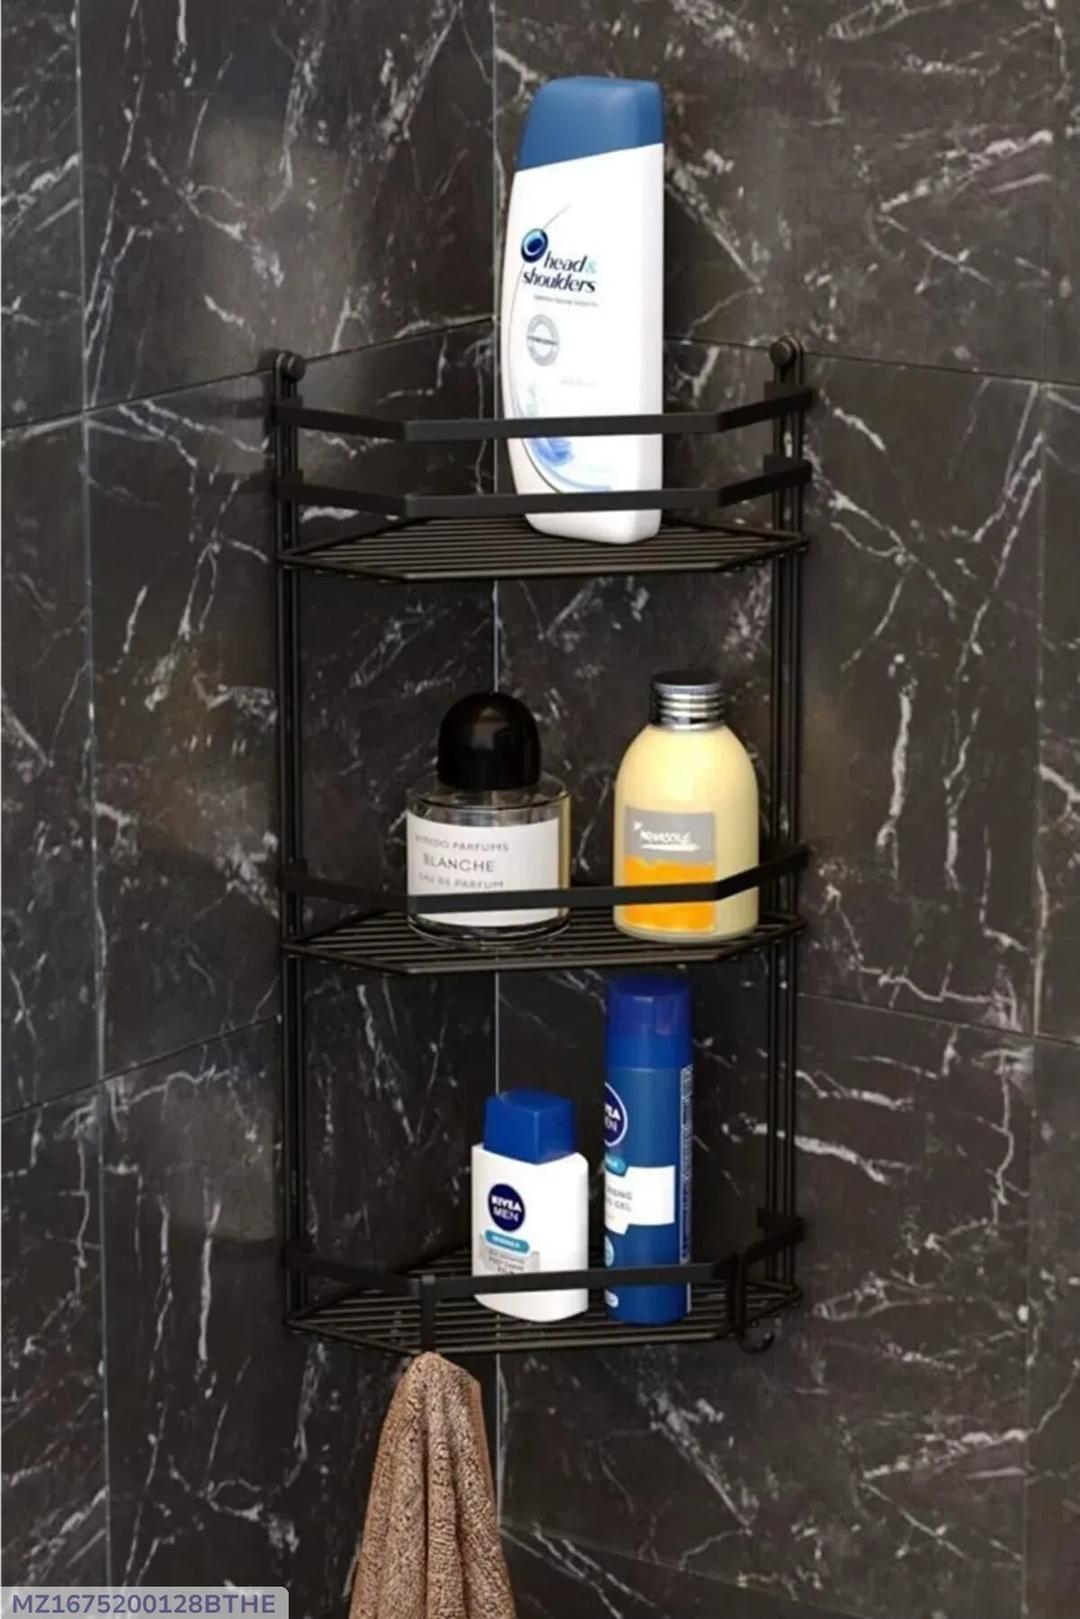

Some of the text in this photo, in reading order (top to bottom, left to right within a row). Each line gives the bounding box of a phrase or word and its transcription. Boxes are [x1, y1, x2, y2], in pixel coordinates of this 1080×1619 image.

[523, 267, 597, 293] shoulders
[453, 841, 510, 852] PARFUMS
[423, 852, 496, 873] BLANCHE
[454, 879, 504, 889] PARFUM
[491, 1194, 522, 1213] NIVEA
[492, 1206, 519, 1223] MEN
